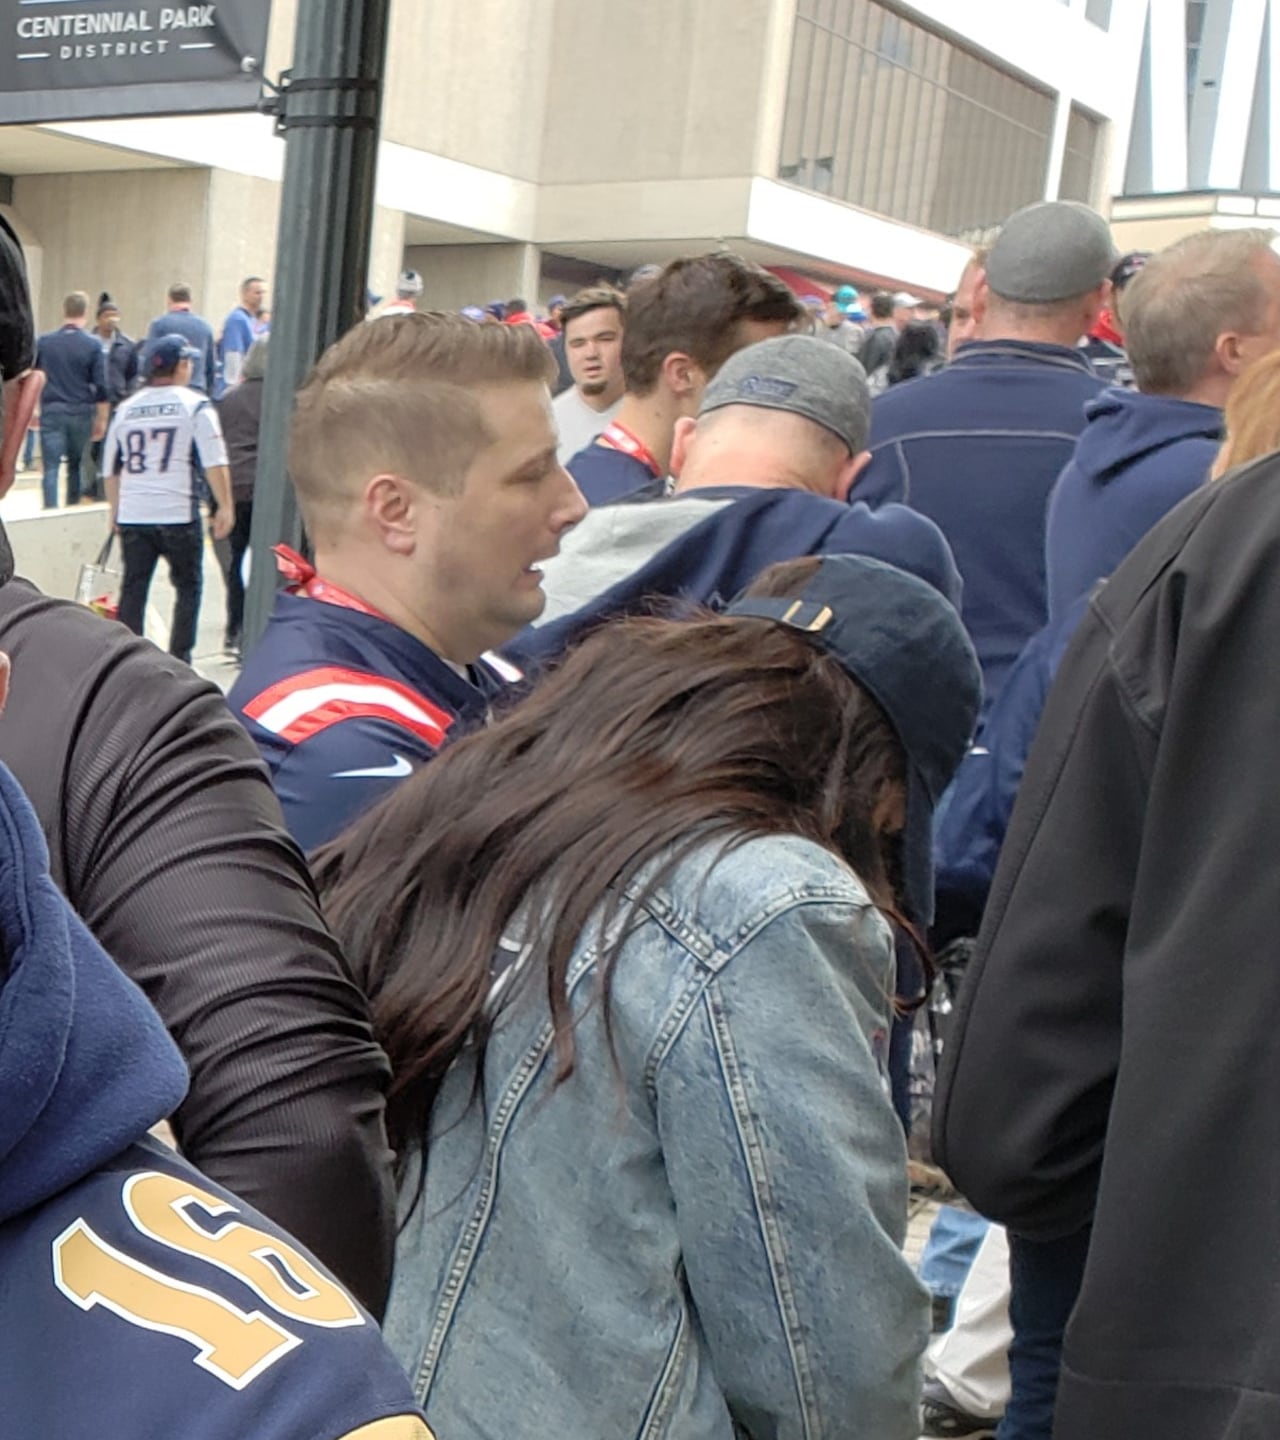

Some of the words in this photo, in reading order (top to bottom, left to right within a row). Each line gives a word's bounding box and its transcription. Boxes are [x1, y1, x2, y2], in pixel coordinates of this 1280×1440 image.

[17, 10, 153, 39] CENTENNIAL
[159, 5, 216, 29] PARK
[60, 40, 169, 59] DISTRICT
[127, 427, 178, 474] 87
[52, 1170, 366, 1390] 16
